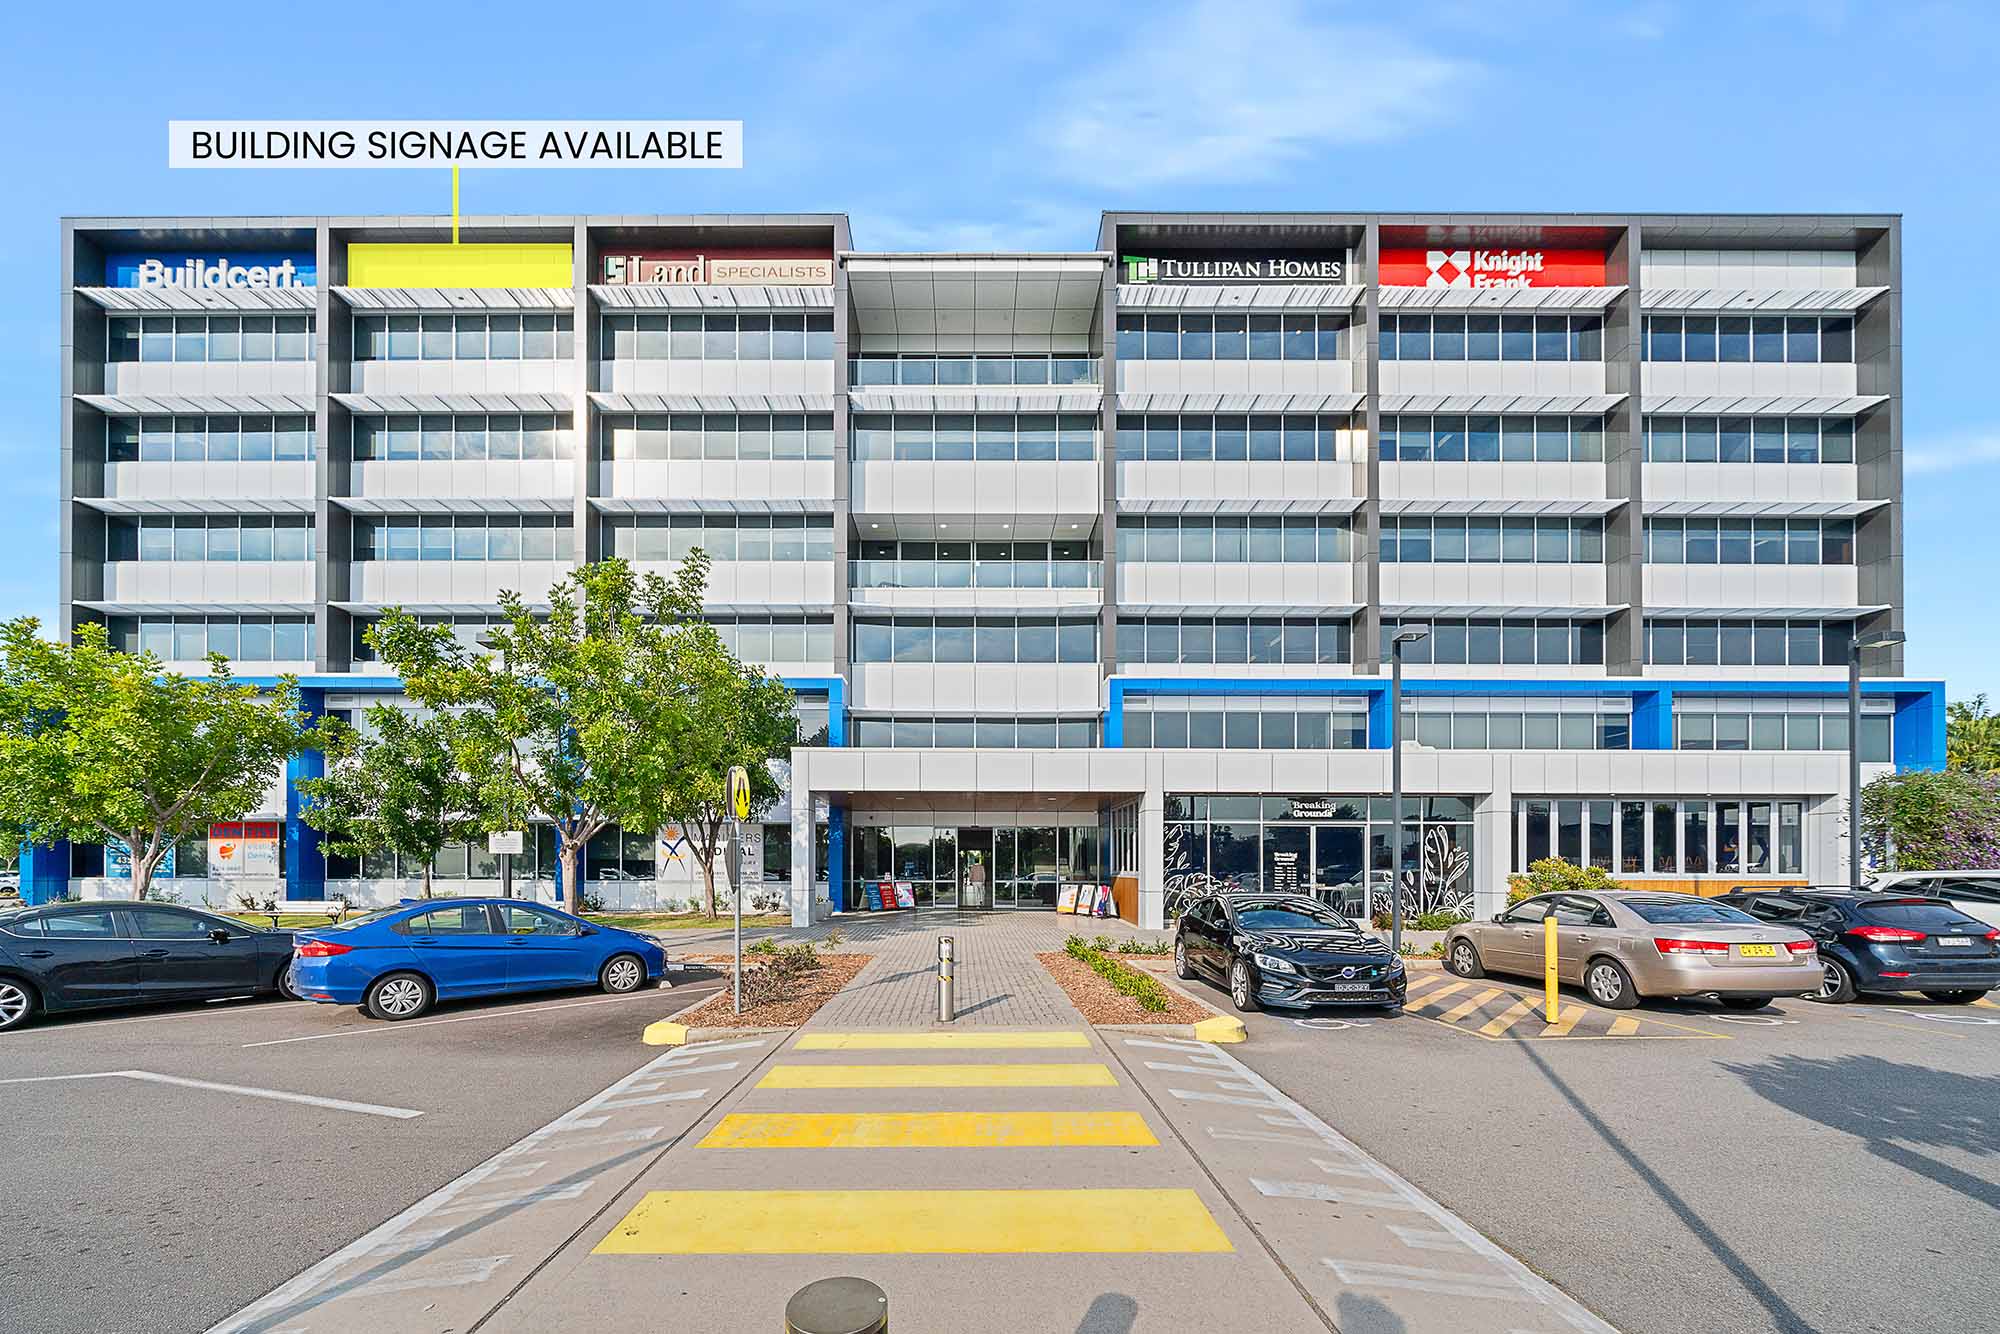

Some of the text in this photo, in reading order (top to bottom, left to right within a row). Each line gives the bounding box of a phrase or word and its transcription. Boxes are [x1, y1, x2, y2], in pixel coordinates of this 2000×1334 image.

[627, 254, 708, 285] Land
[716, 266, 827, 279] SPECIALISTS
[1160, 258, 1261, 278] TULLIPAN
[1268, 258, 1342, 278] HOMES
[1473, 250, 1545, 277] Knight
[1293, 801, 1337, 812] Breaking
[1293, 809, 1333, 818] Grounds
[212, 827, 276, 837] DENTIST
